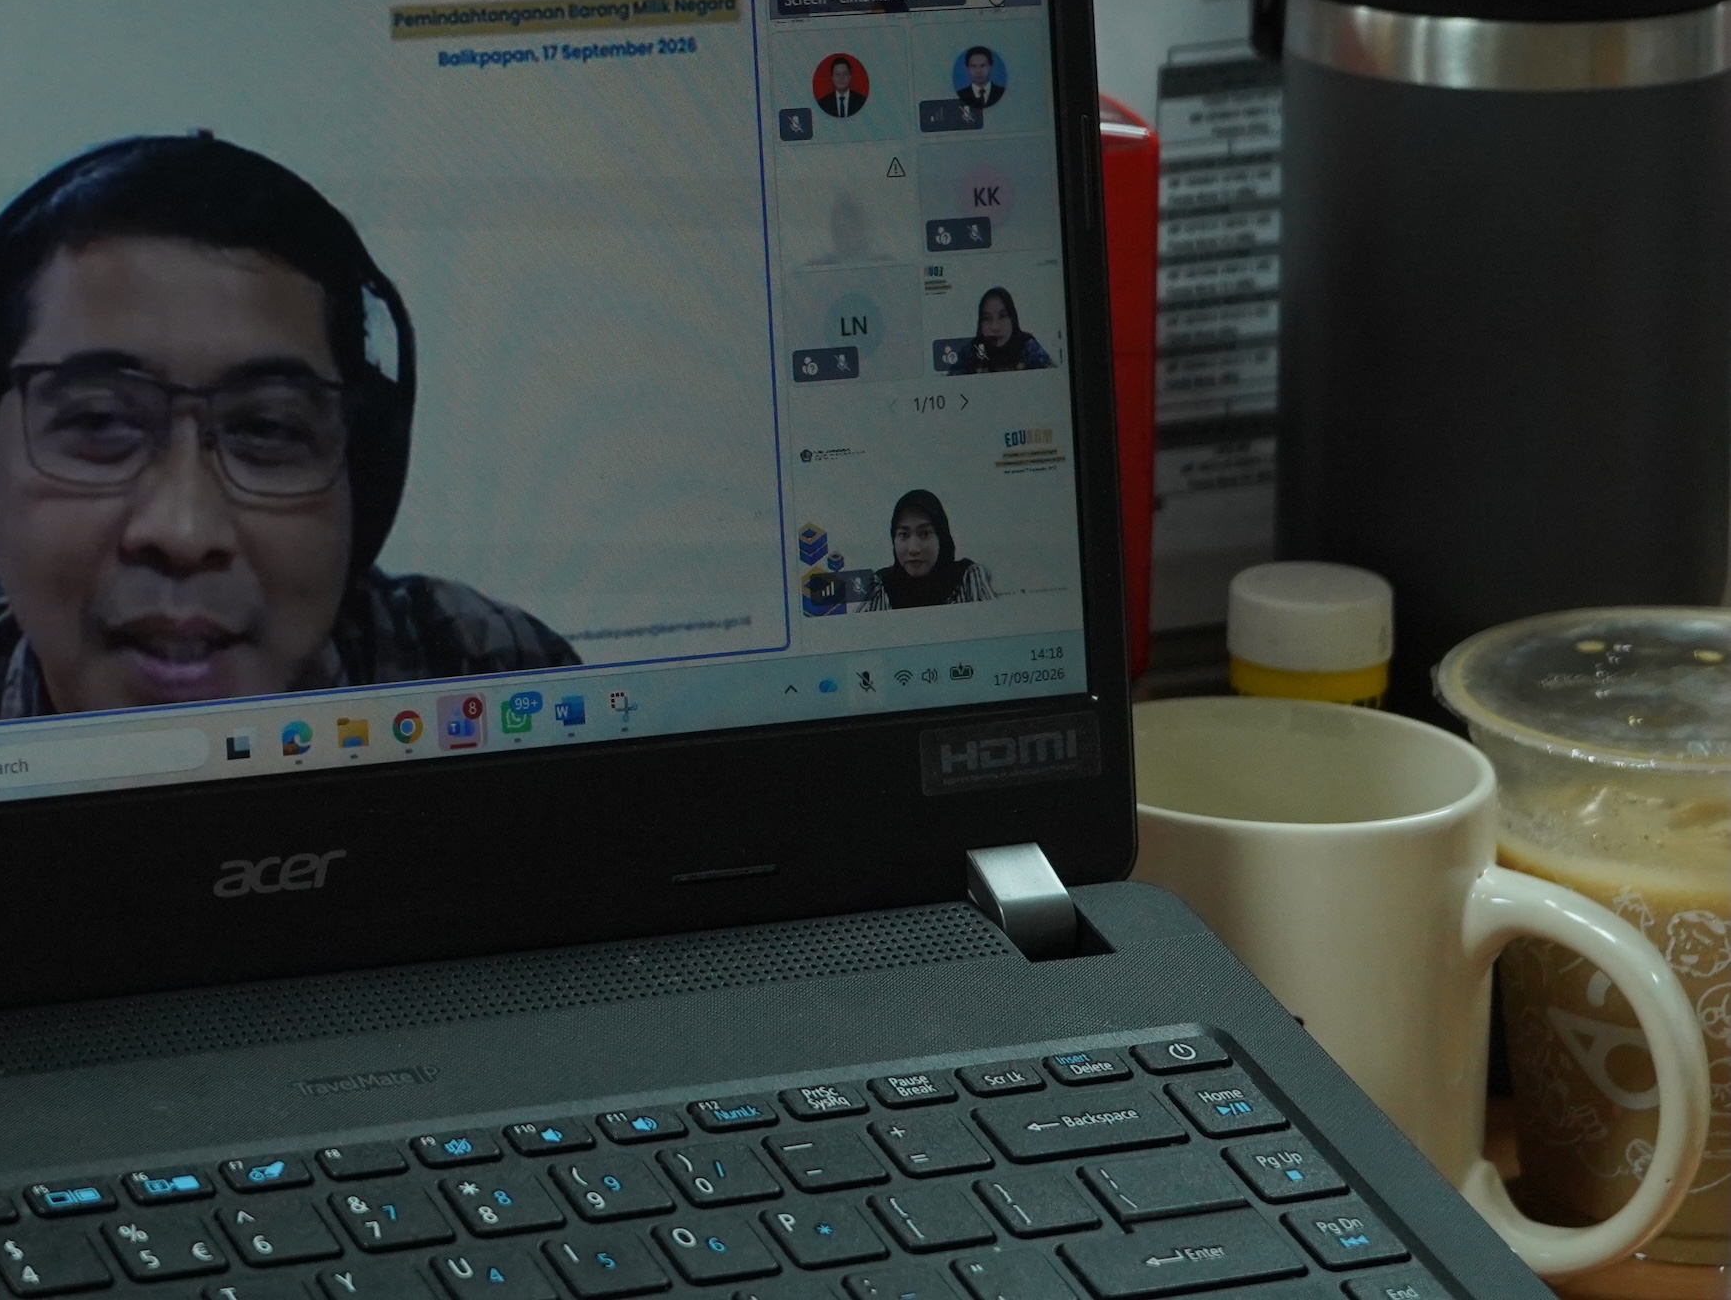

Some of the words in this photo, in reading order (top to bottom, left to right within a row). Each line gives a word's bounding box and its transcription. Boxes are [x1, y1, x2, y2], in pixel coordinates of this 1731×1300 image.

[394, 6, 564, 29] Pemindahtanganan
[568, 2, 630, 22] Barang
[438, 47, 539, 69] Balikpapan,
[542, 45, 558, 60] 17
[561, 41, 654, 63] September
[973, 186, 1000, 207] KK
[840, 316, 867, 337] LN
[914, 395, 946, 413] 1/10
[1030, 647, 1064, 661] 14:18
[994, 668, 1065, 687] 17/09/2026
[468, 703, 477, 714] 8
[514, 696, 538, 710] 99+
[556, 705, 569, 718] W
[940, 730, 1078, 776] HDMI
[213, 849, 348, 898] acer
[1055, 1053, 1090, 1065] Insert
[1070, 1061, 1114, 1075] Delete
[887, 1074, 930, 1088] Pause
[984, 1073, 1006, 1086] Scr
[1006, 1071, 1025, 1083] Lk
[801, 1086, 839, 1099] PrtSc
[895, 1083, 937, 1097] Break
[1198, 1087, 1244, 1103] Home
[698, 1100, 721, 1111] F12
[807, 1096, 852, 1111] SysRq
[605, 1112, 628, 1123] F11
[714, 1105, 761, 1121] NumLk
[1061, 1108, 1139, 1128] Backspace
[513, 1123, 536, 1135] F10
[420, 1136, 436, 1147] F9
[325, 1148, 341, 1159] F8
[1255, 1154, 1280, 1170] Pg
[1280, 1150, 1303, 1166] Up
[227, 1160, 244, 1171] F7
[131, 1171, 149, 1182] F6
[603, 1175, 622, 1192] 9
[32, 1184, 49, 1196] F5
[493, 1190, 513, 1207] 8
[585, 1190, 606, 1210] 9
[382, 1204, 397, 1221] 7
[477, 1205, 499, 1225] 8
[364, 1220, 382, 1240] 7
[777, 1213, 796, 1233] P
[1316, 1220, 1340, 1236] Pg
[1341, 1216, 1364, 1231] Dn
[117, 1223, 149, 1244] %
[3, 1239, 24, 1262] $
[252, 1234, 273, 1255] 6
[707, 1236, 726, 1253] 6
[138, 1249, 161, 1269] 5
[596, 1252, 616, 1270] 5
[1184, 1245, 1226, 1262] Enter
[21, 1265, 41, 1284] 4
[447, 1257, 474, 1279] U
[487, 1267, 505, 1284] 4
[334, 1271, 357, 1293] Y
[1386, 1285, 1419, 1300] End
